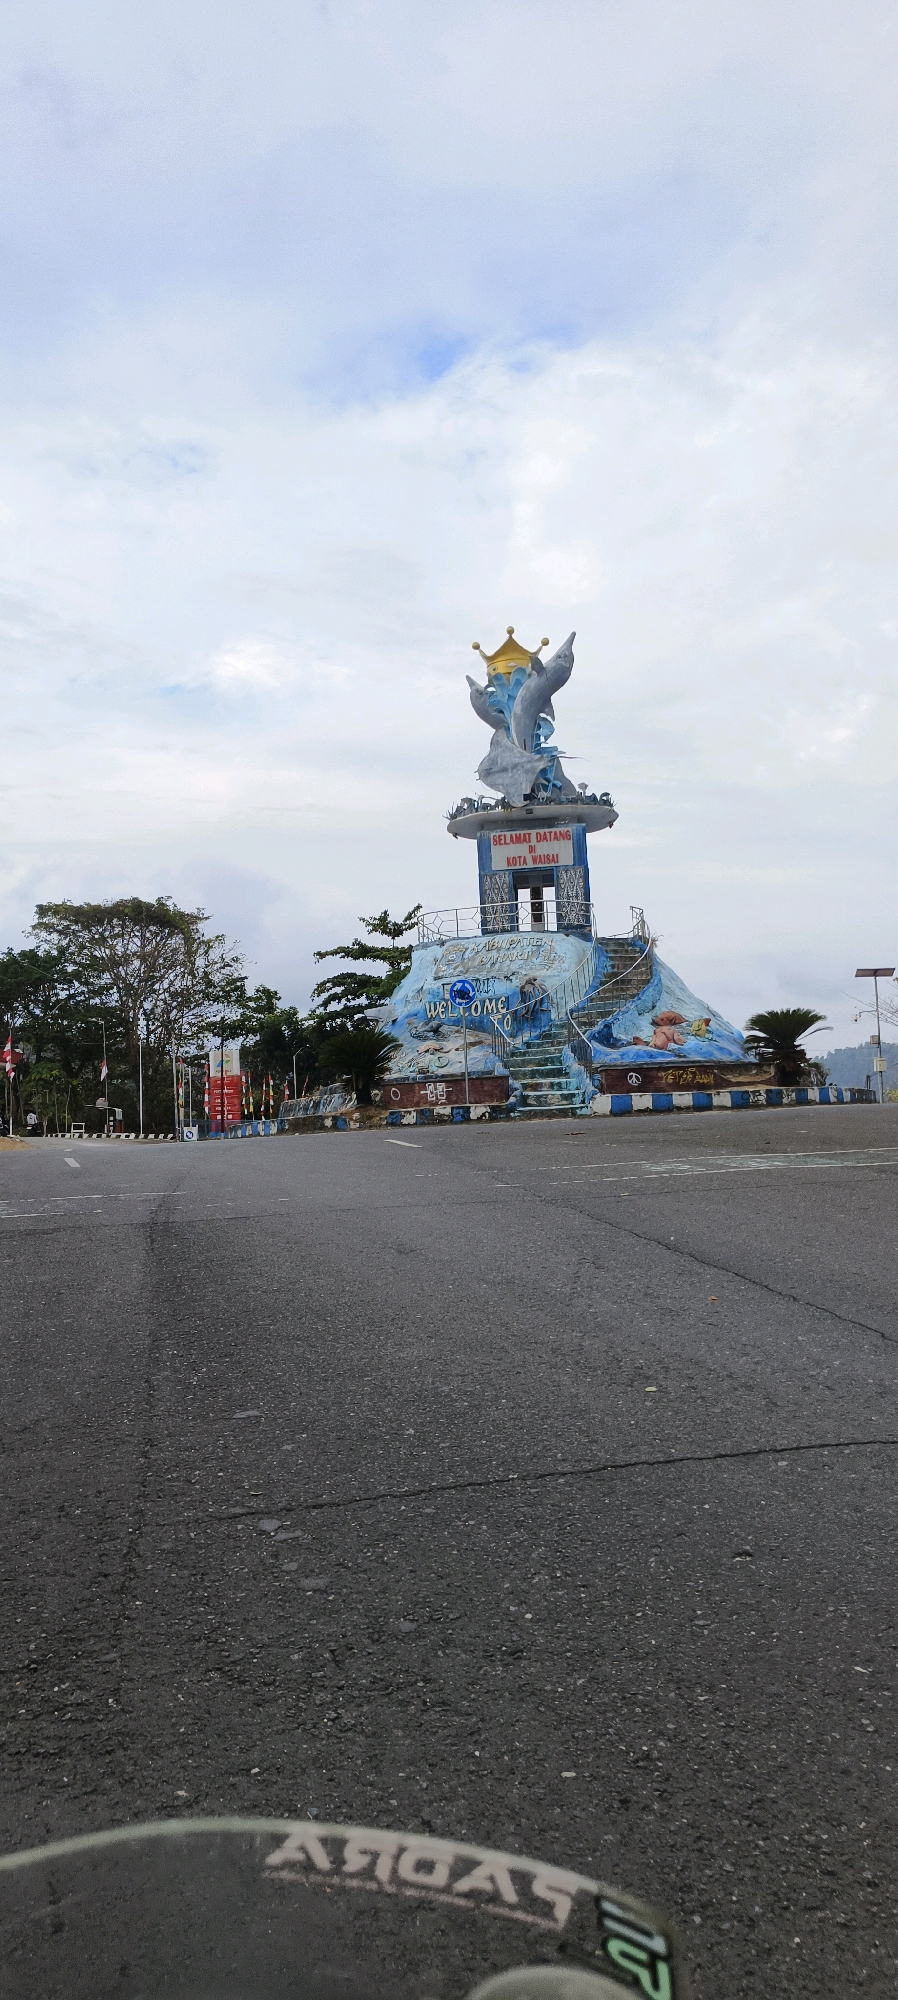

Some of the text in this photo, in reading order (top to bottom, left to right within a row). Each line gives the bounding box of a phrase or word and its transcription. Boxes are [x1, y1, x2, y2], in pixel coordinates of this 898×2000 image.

[492, 829, 572, 846] SELAMAT DATANG
[528, 844, 537, 854] DI
[506, 853, 559, 867] KOTA WAISAI
[470, 936, 554, 953] KABUPATEN
[491, 1013, 512, 1031] TO
